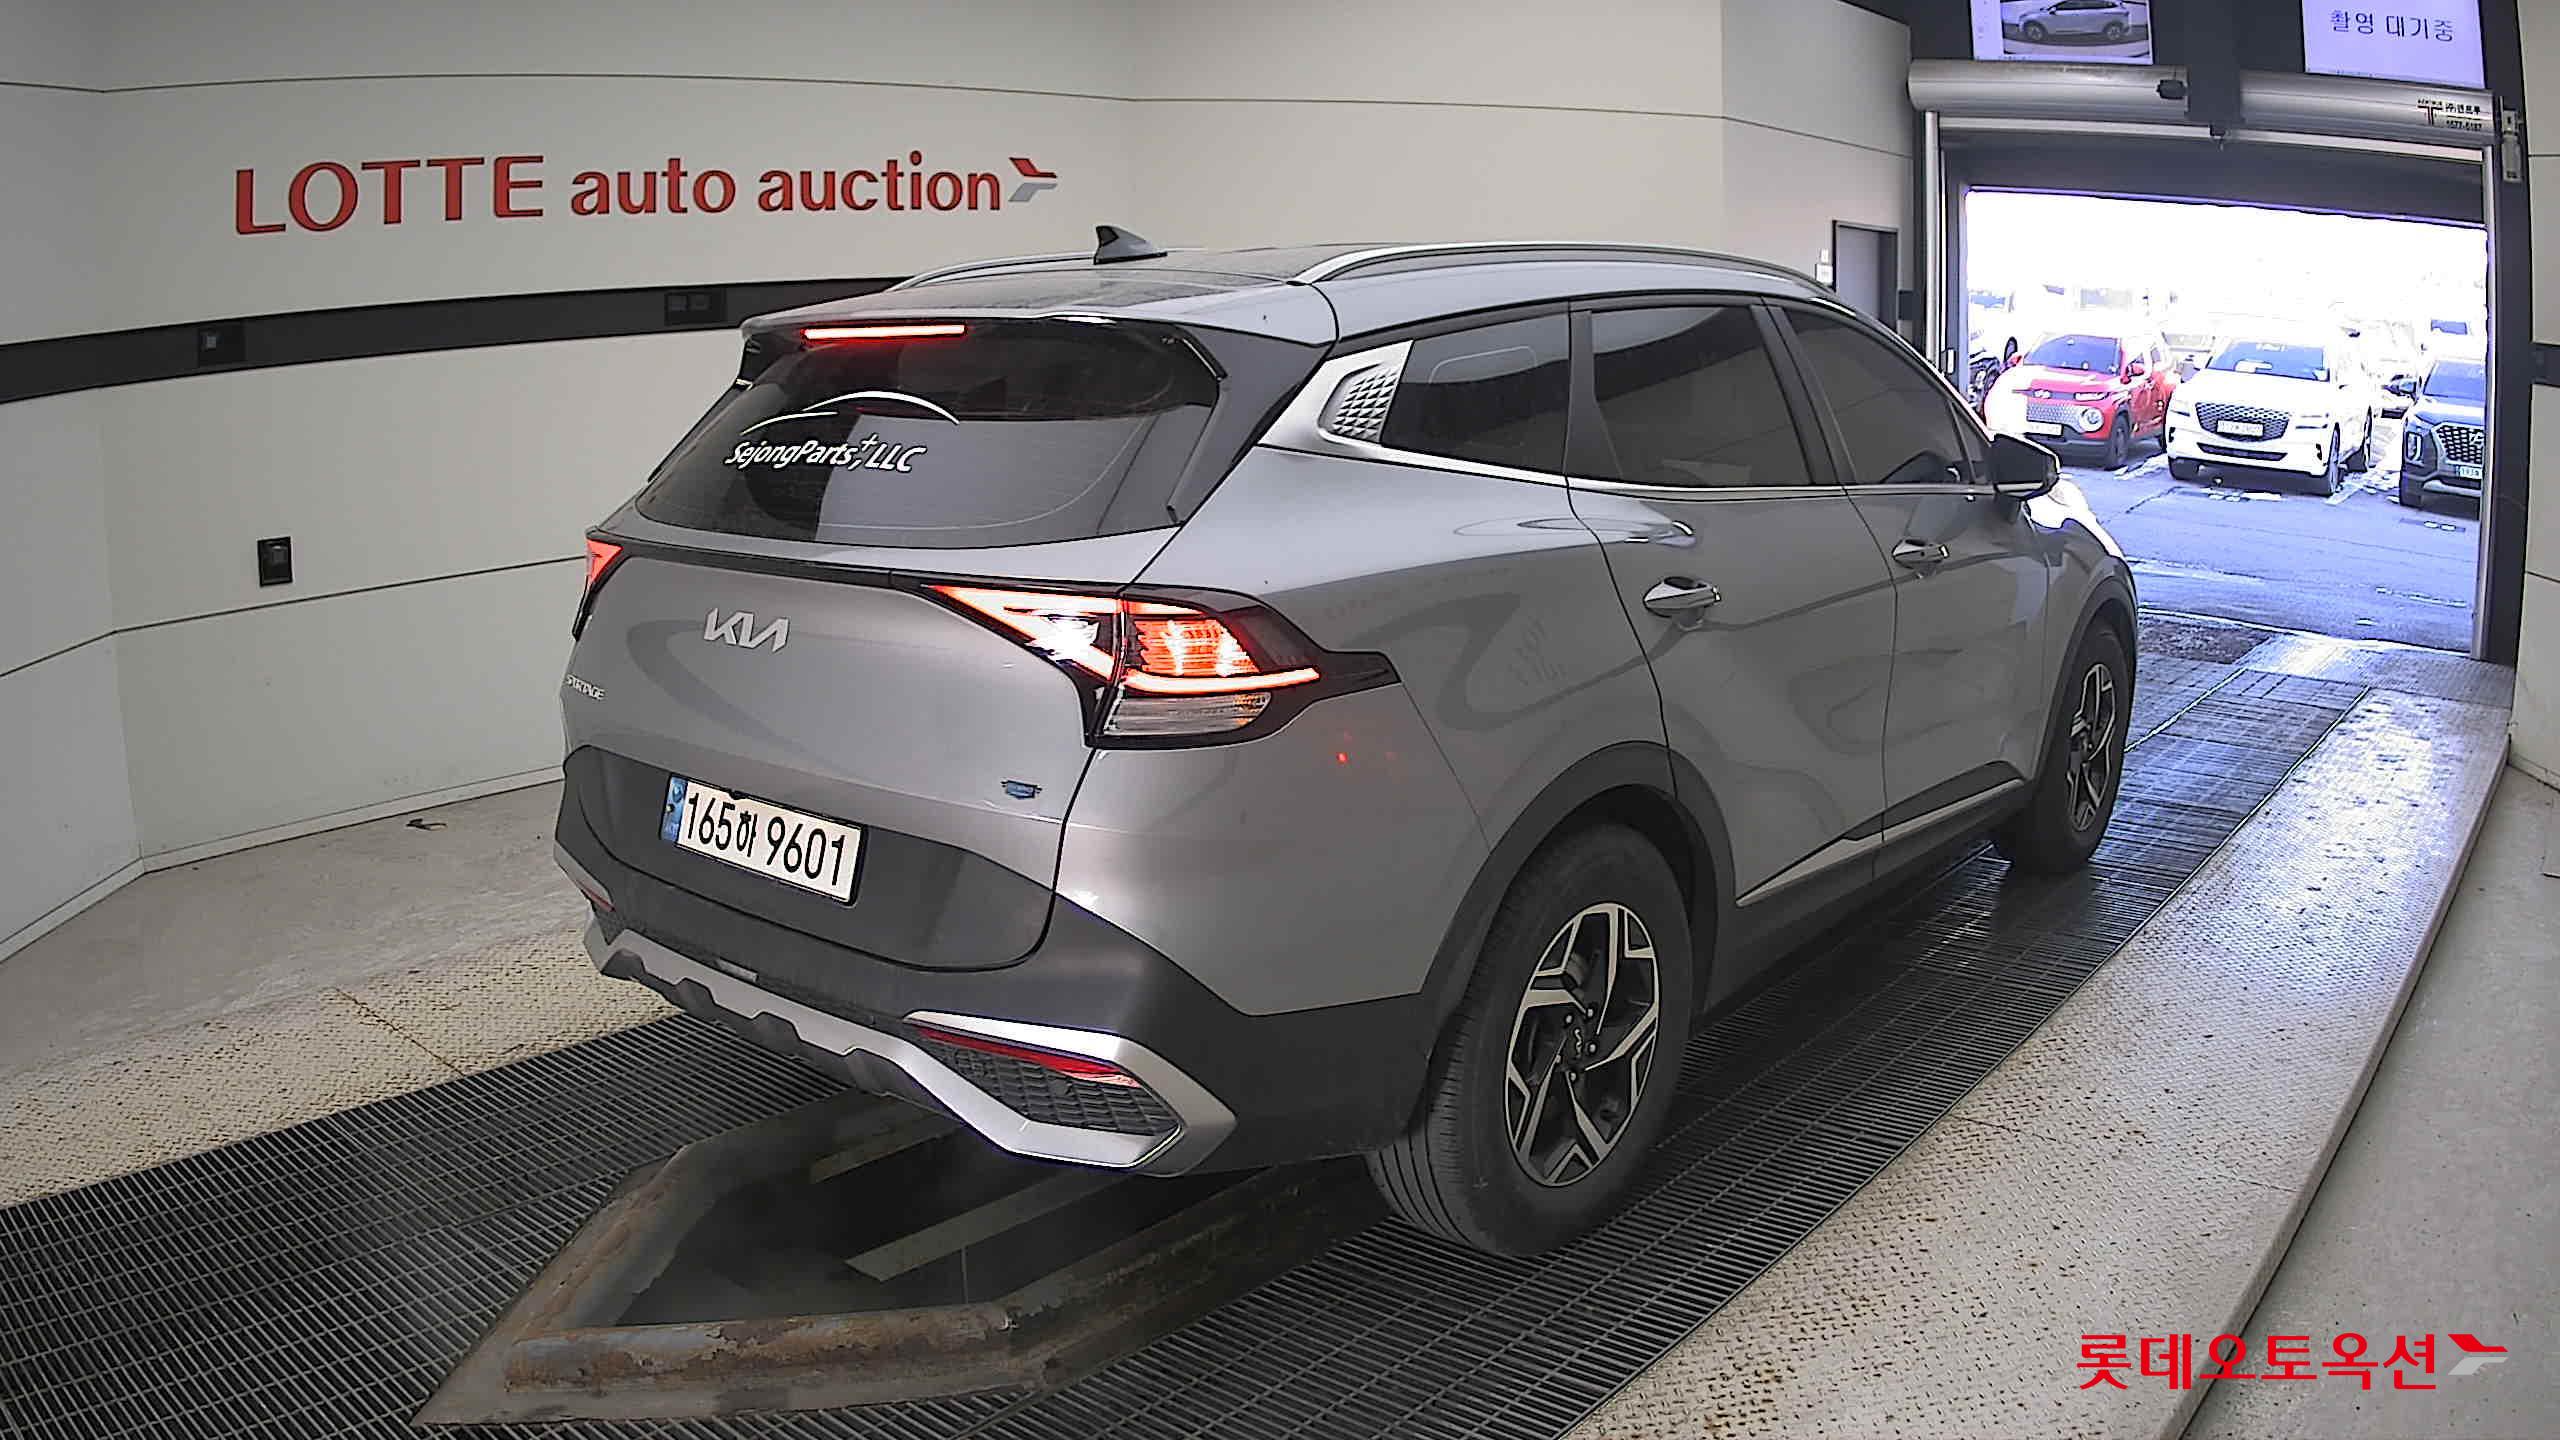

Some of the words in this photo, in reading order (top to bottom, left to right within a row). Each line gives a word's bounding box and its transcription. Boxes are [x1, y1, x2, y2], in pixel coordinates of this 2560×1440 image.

[2330, 9, 2374, 35] 촬영
[2386, 15, 2453, 42] 대기중
[235, 155, 544, 234] LOTTE
[570, 157, 736, 215] auto
[758, 150, 1000, 212] auction
[704, 607, 790, 653] KIA
[687, 793, 757, 858] 165하
[766, 816, 846, 886] 9601
